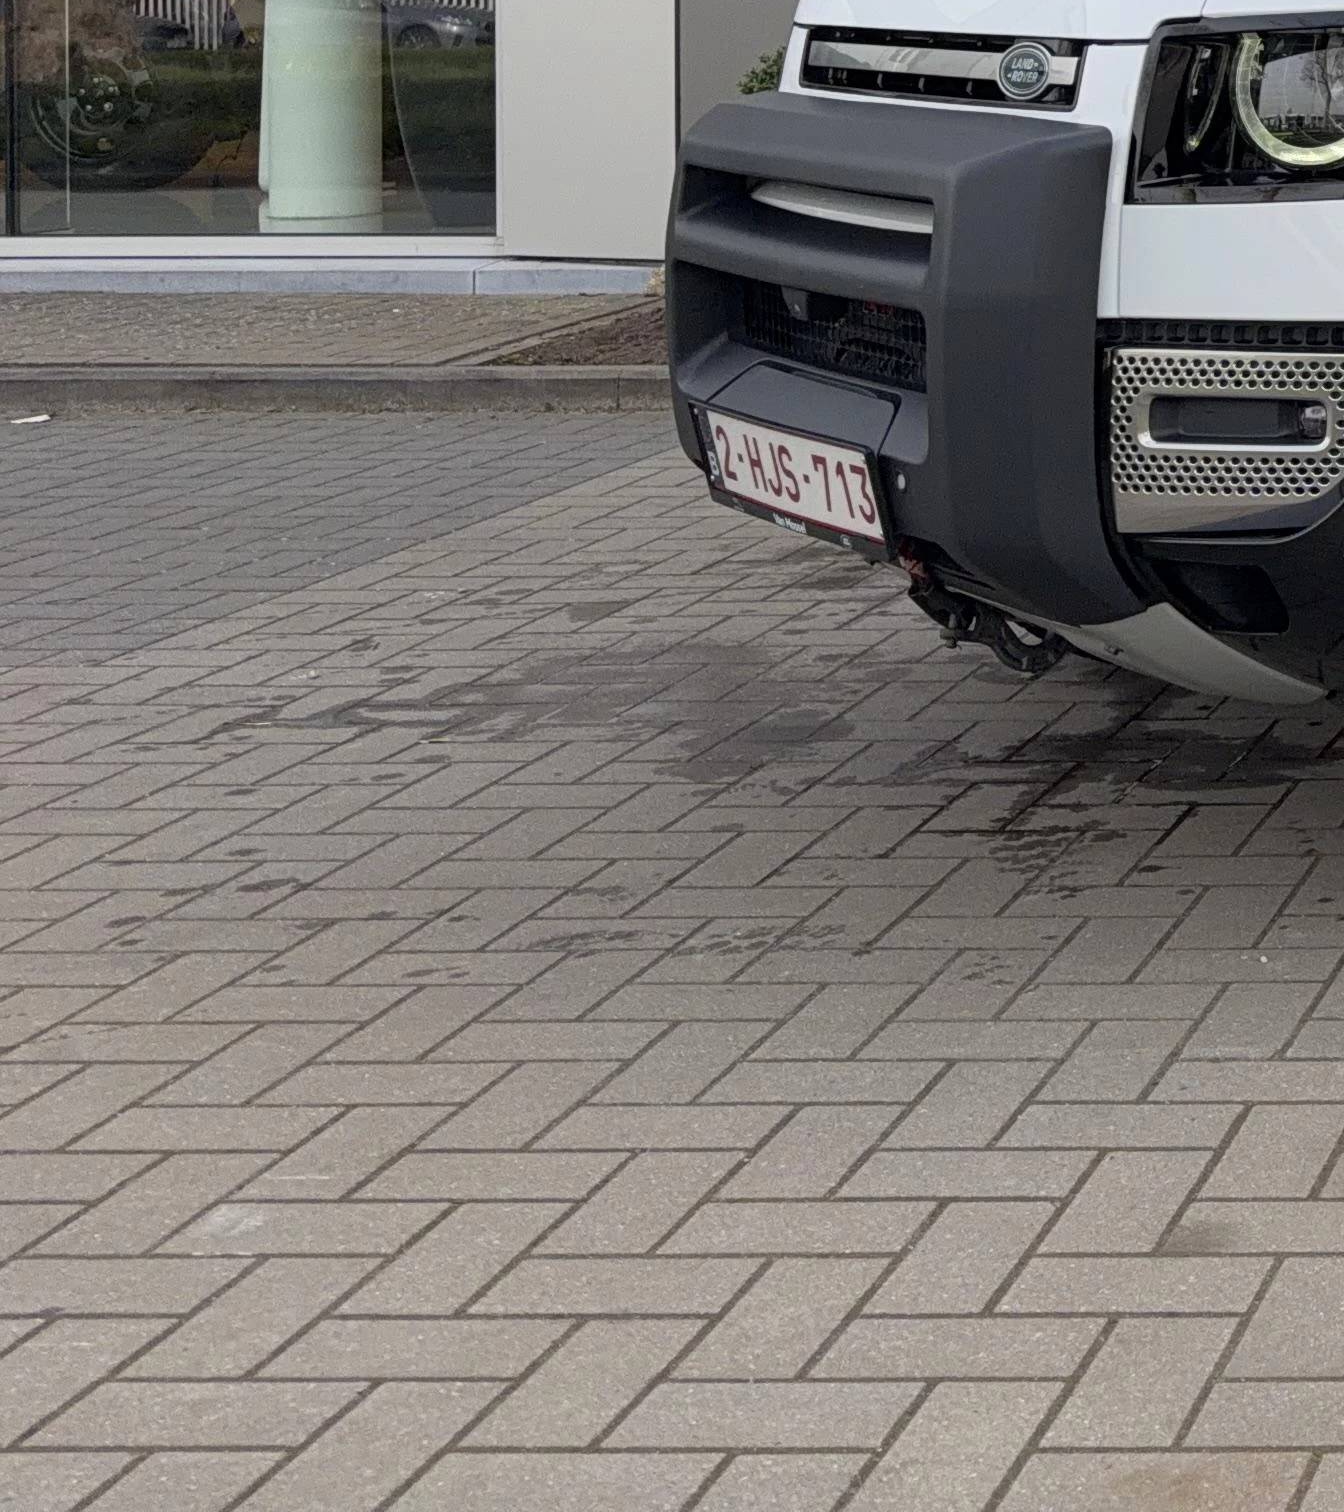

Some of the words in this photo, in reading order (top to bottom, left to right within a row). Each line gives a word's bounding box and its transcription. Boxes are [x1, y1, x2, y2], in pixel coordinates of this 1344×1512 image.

[1011, 57, 1035, 70] LAND
[1010, 70, 1039, 83] ROVER
[707, 450, 720, 476] B
[715, 424, 876, 525] 2-HJS-713
